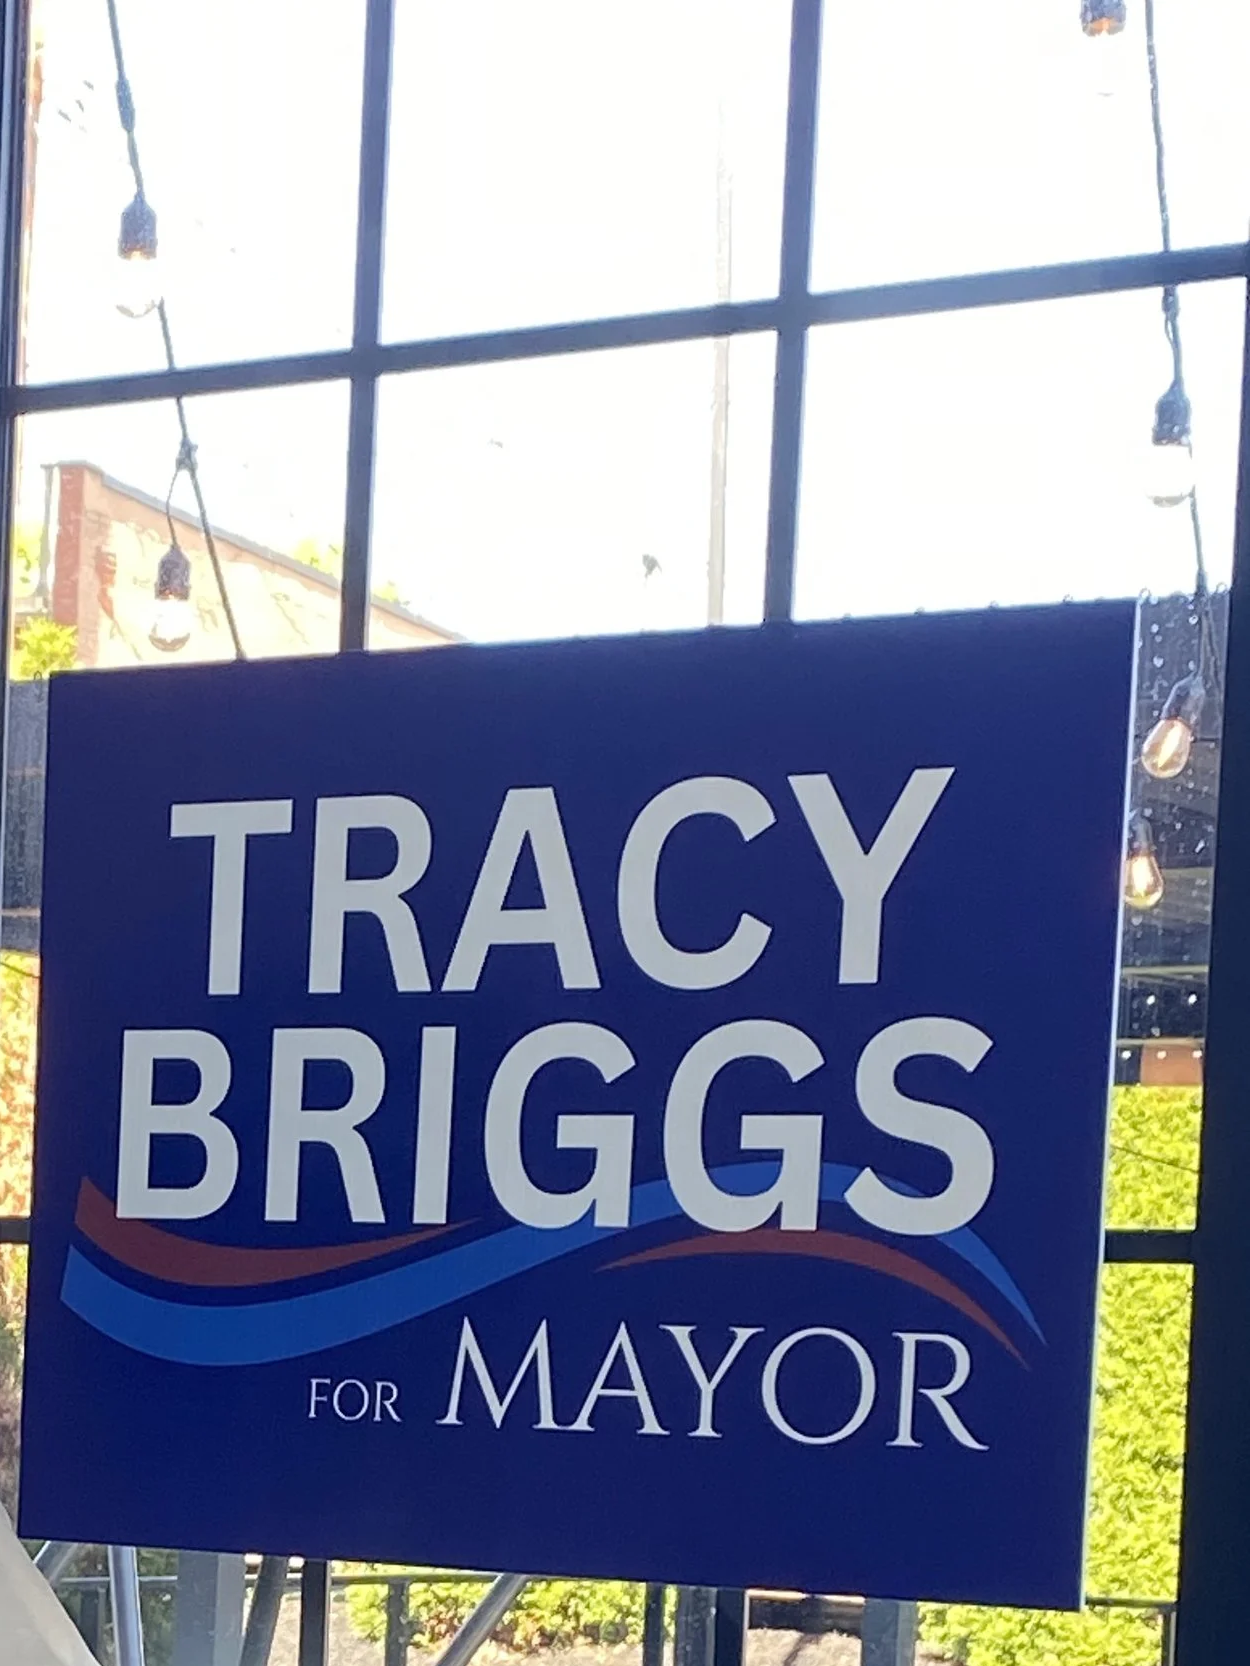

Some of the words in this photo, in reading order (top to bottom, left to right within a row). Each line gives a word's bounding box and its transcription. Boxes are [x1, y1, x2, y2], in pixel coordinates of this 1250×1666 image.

[170, 767, 955, 995] TRACY
[116, 1017, 994, 1236] BRIGGS
[307, 1377, 402, 1423] FOR
[437, 1315, 989, 1451] MAYOR
